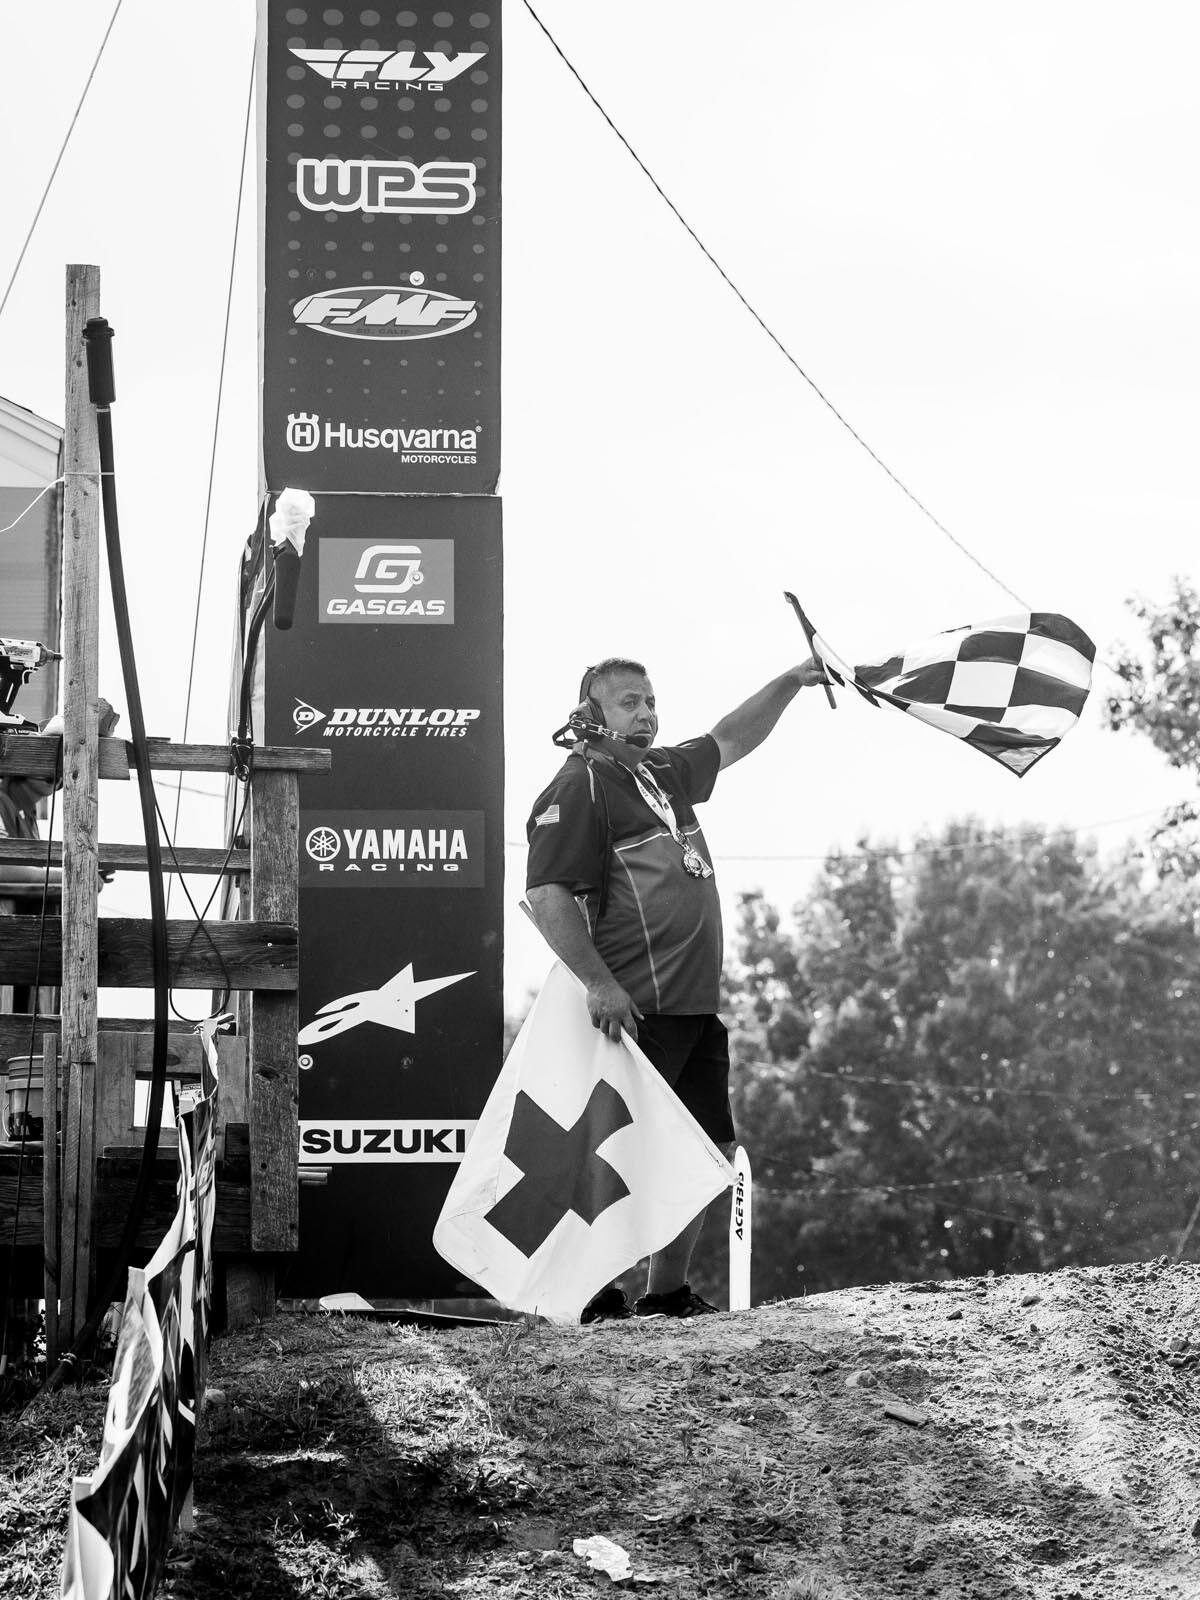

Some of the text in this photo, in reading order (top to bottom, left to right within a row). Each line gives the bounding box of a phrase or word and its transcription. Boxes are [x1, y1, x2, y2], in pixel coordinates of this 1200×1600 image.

[288, 48, 488, 82] FLY
[331, 81, 443, 91] RACING
[297, 159, 476, 214] WPS
[295, 294, 477, 326] FMF
[325, 423, 477, 453] Husqvarna
[401, 455, 477, 464] MOTORCYCLES
[327, 599, 445, 616] GASGAS
[327, 708, 480, 726] DUNLOP
[323, 726, 467, 737] MOTORCYCLE TIRES
[343, 829, 468, 860] YAMAHA
[319, 863, 459, 872] RACING
[302, 1128, 465, 1154] SUZUKI
